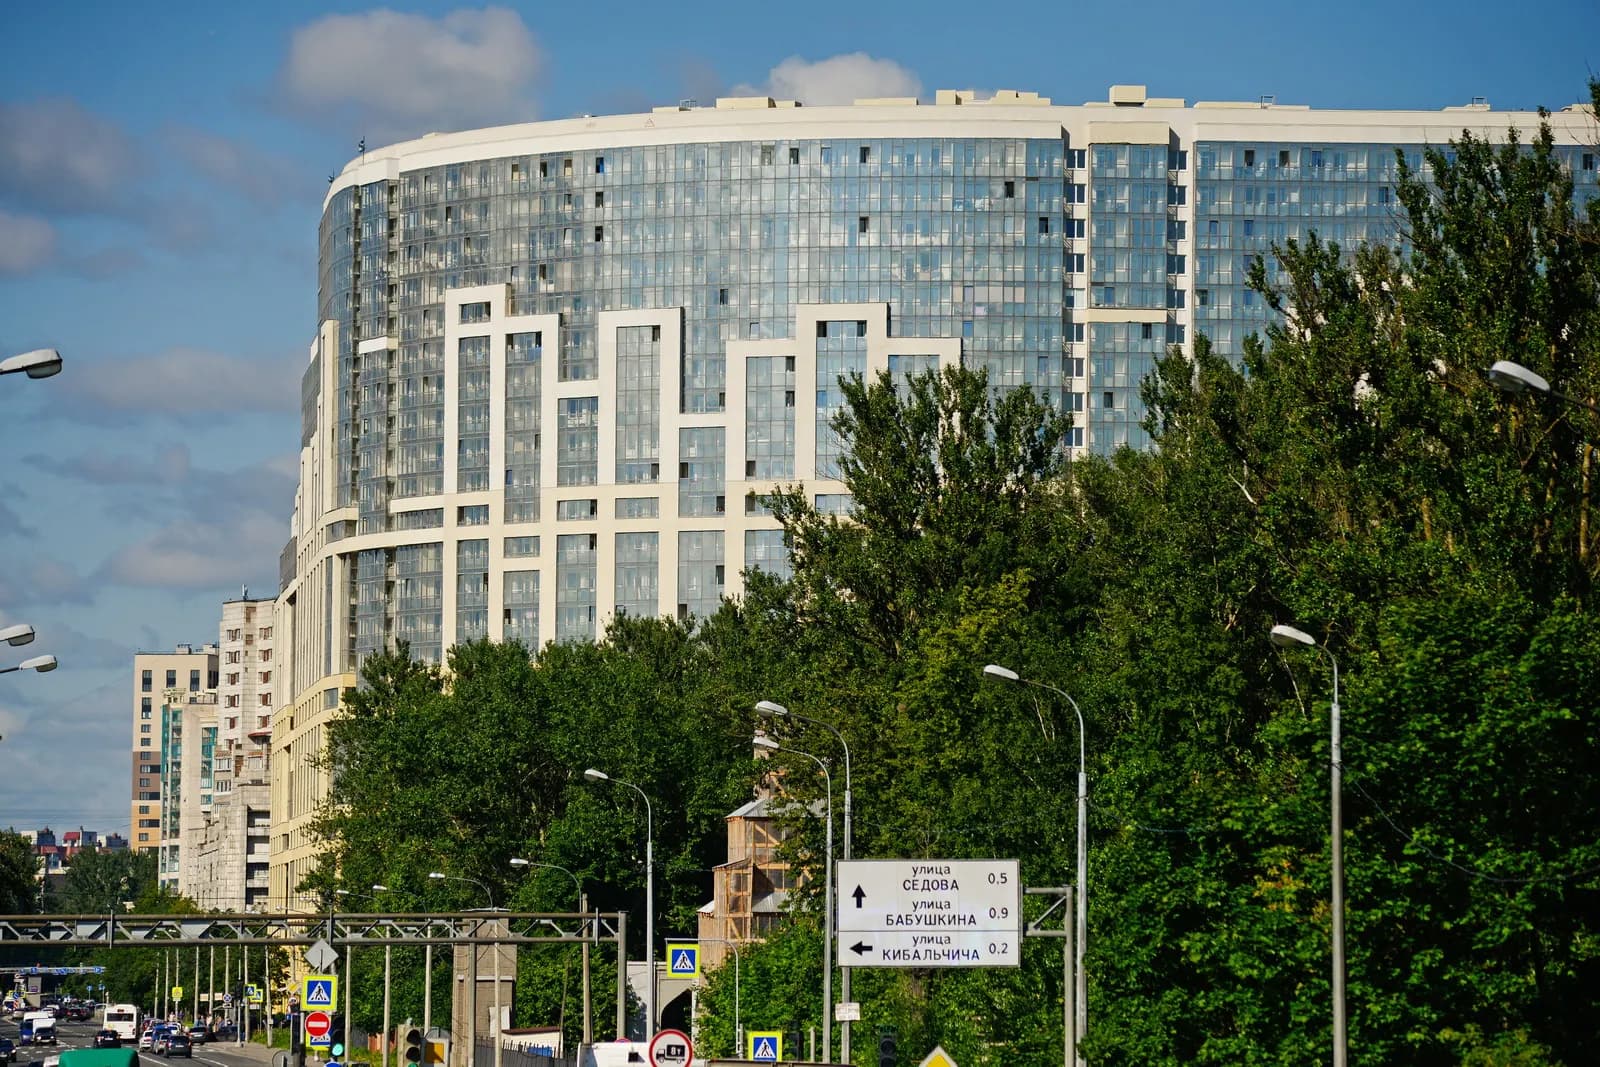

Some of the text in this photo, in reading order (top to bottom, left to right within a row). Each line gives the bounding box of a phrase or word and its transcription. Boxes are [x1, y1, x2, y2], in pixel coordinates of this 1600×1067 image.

[912, 865, 951, 877] улица
[988, 873, 1008, 884] 0.5
[903, 879, 960, 892] СЕДОВА
[912, 900, 951, 912] улица
[989, 907, 1009, 918] 0.9
[886, 914, 977, 926] БАБУШКИНА
[912, 935, 951, 947] улица
[883, 949, 980, 961] КИБАЛЬЧИЧА
[989, 943, 1008, 955] 0.2
